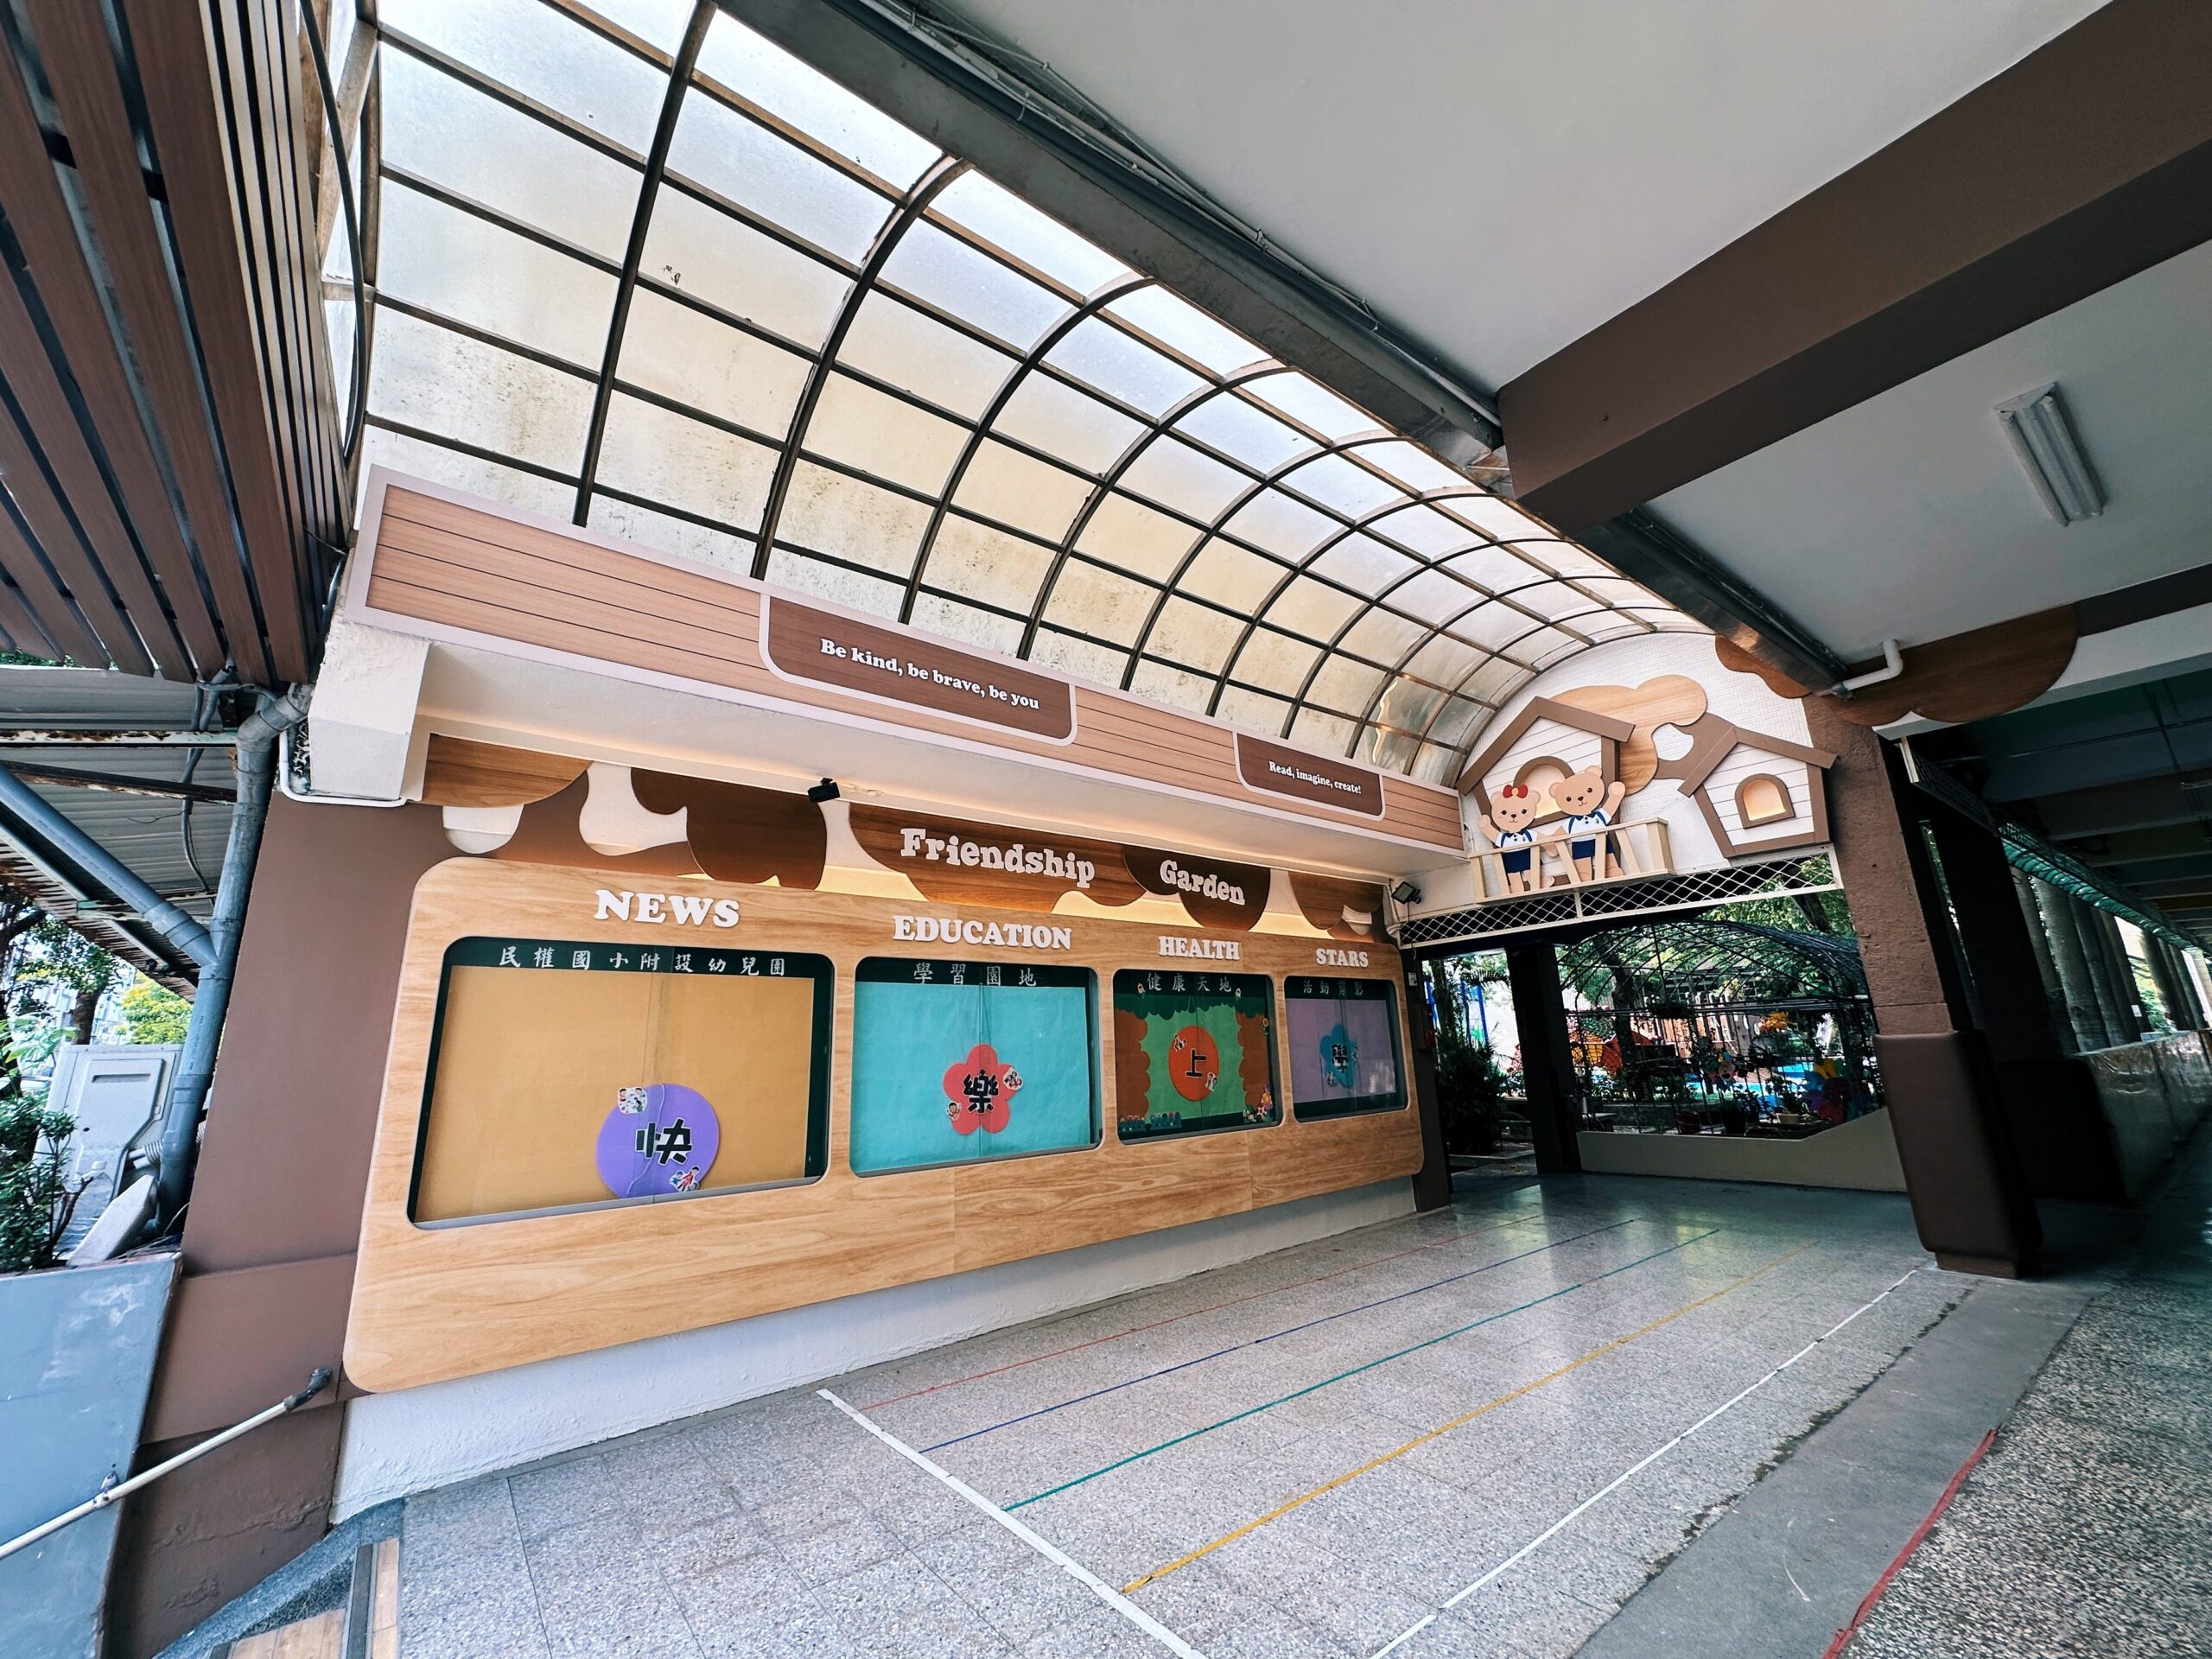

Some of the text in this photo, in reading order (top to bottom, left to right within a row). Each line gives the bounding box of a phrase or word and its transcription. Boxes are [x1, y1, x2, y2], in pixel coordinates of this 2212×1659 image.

[820, 639, 1039, 710] Be kind, be brave, be you
[1268, 760, 1362, 794] Read, imagine, create!
[899, 828, 1245, 906] Friendship Garden
[594, 888, 741, 928] NEWS
[893, 915, 1072, 950] EDUCATION
[1158, 936, 1240, 960] HEALTH
[499, 945, 785, 976] 民權國小附設幼兒園
[913, 963, 1037, 987] 學習園地
[1316, 948, 1369, 968] STARS
[1147, 972, 1232, 992] 健康天地
[1185, 1048, 1207, 1077] 上
[963, 1070, 998, 1114] 樂
[635, 1117, 693, 1166] 快
